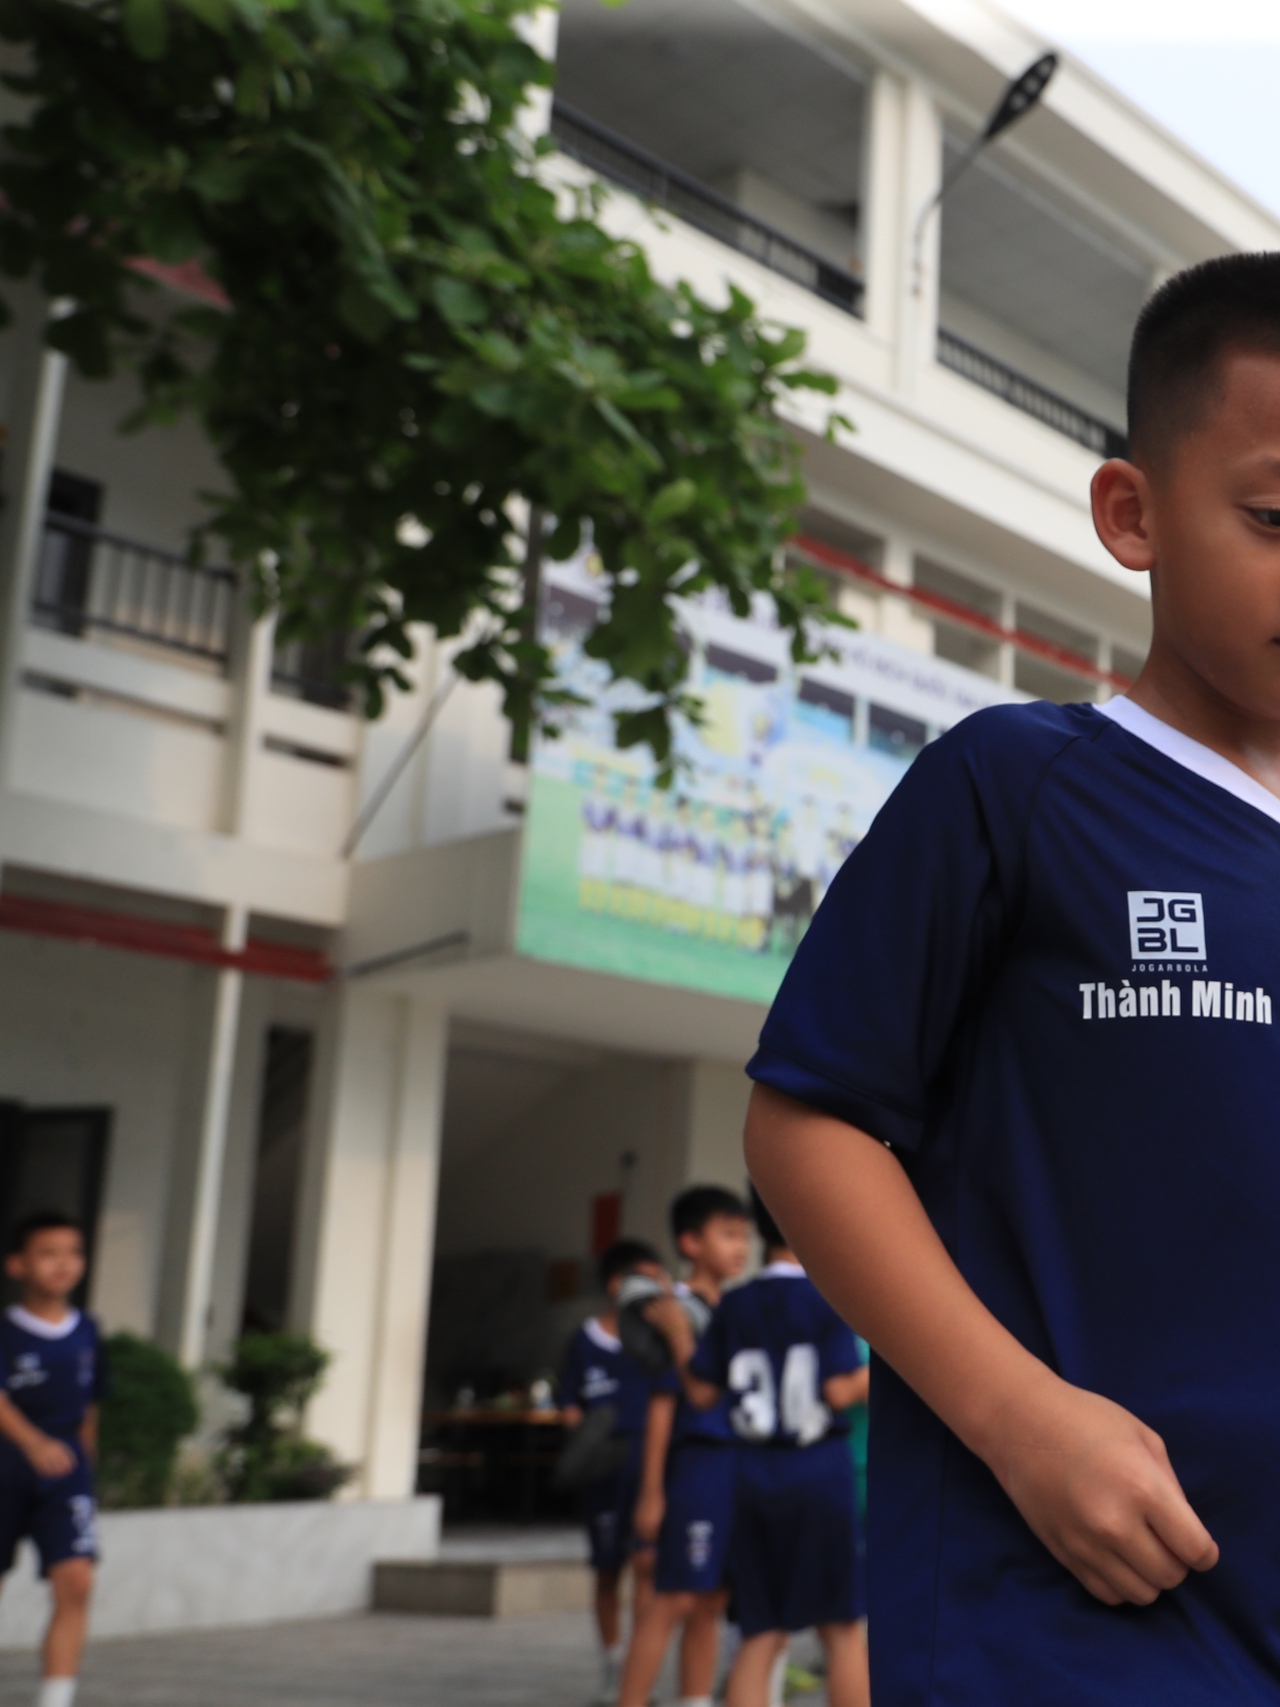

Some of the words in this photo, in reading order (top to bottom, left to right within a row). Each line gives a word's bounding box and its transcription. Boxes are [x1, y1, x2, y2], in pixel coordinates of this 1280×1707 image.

[1137, 898, 1197, 922] JG
[1137, 928, 1199, 953] BL
[1132, 963, 1209, 973] JOGARBOLA
[1079, 980, 1181, 1020] Thành
[1191, 980, 1273, 1025] Minh
[729, 1343, 830, 1447] 34
